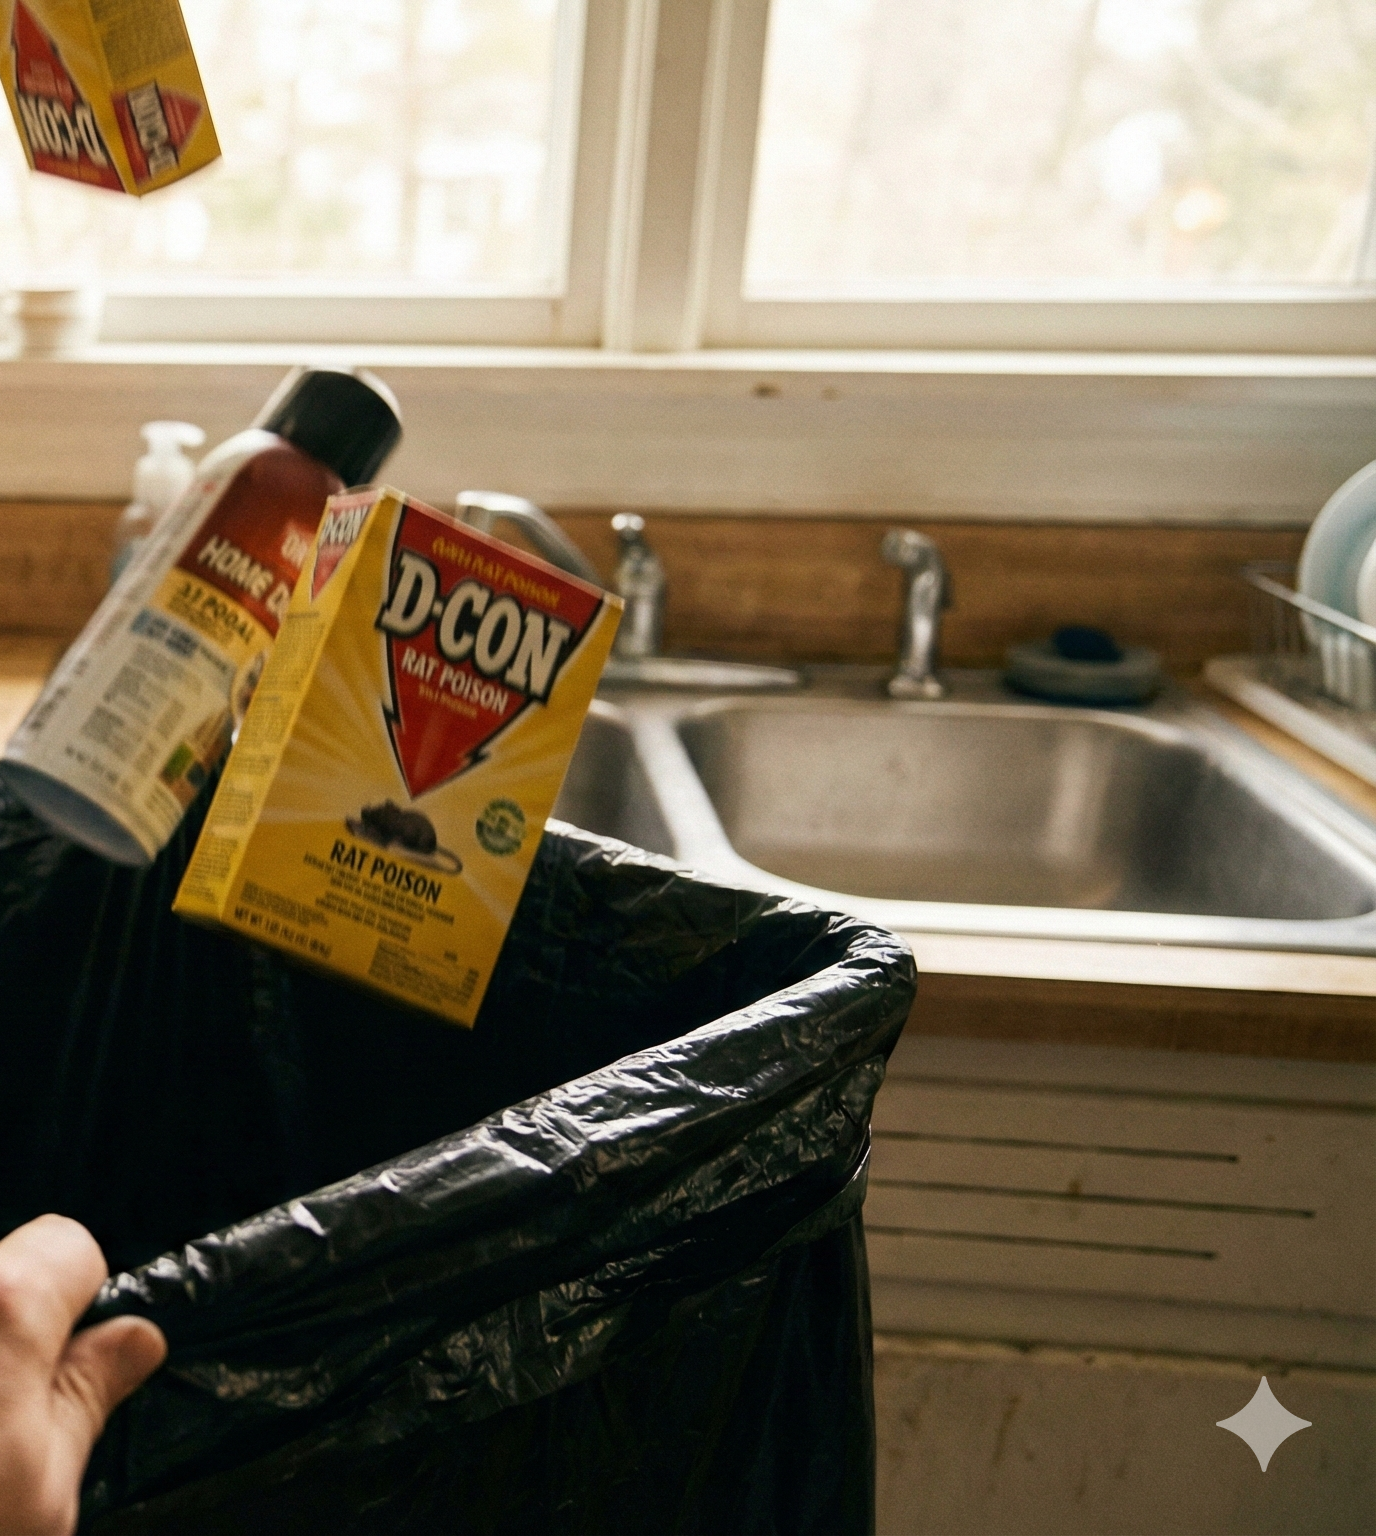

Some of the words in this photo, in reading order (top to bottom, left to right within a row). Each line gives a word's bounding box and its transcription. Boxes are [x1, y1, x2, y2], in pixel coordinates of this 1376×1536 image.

[197, 534, 274, 599] HOME
[379, 551, 572, 698] D-CON
[401, 646, 440, 682] RAT
[439, 658, 510, 715] POISON
[330, 839, 369, 873] RAT
[370, 858, 443, 904] POISON
